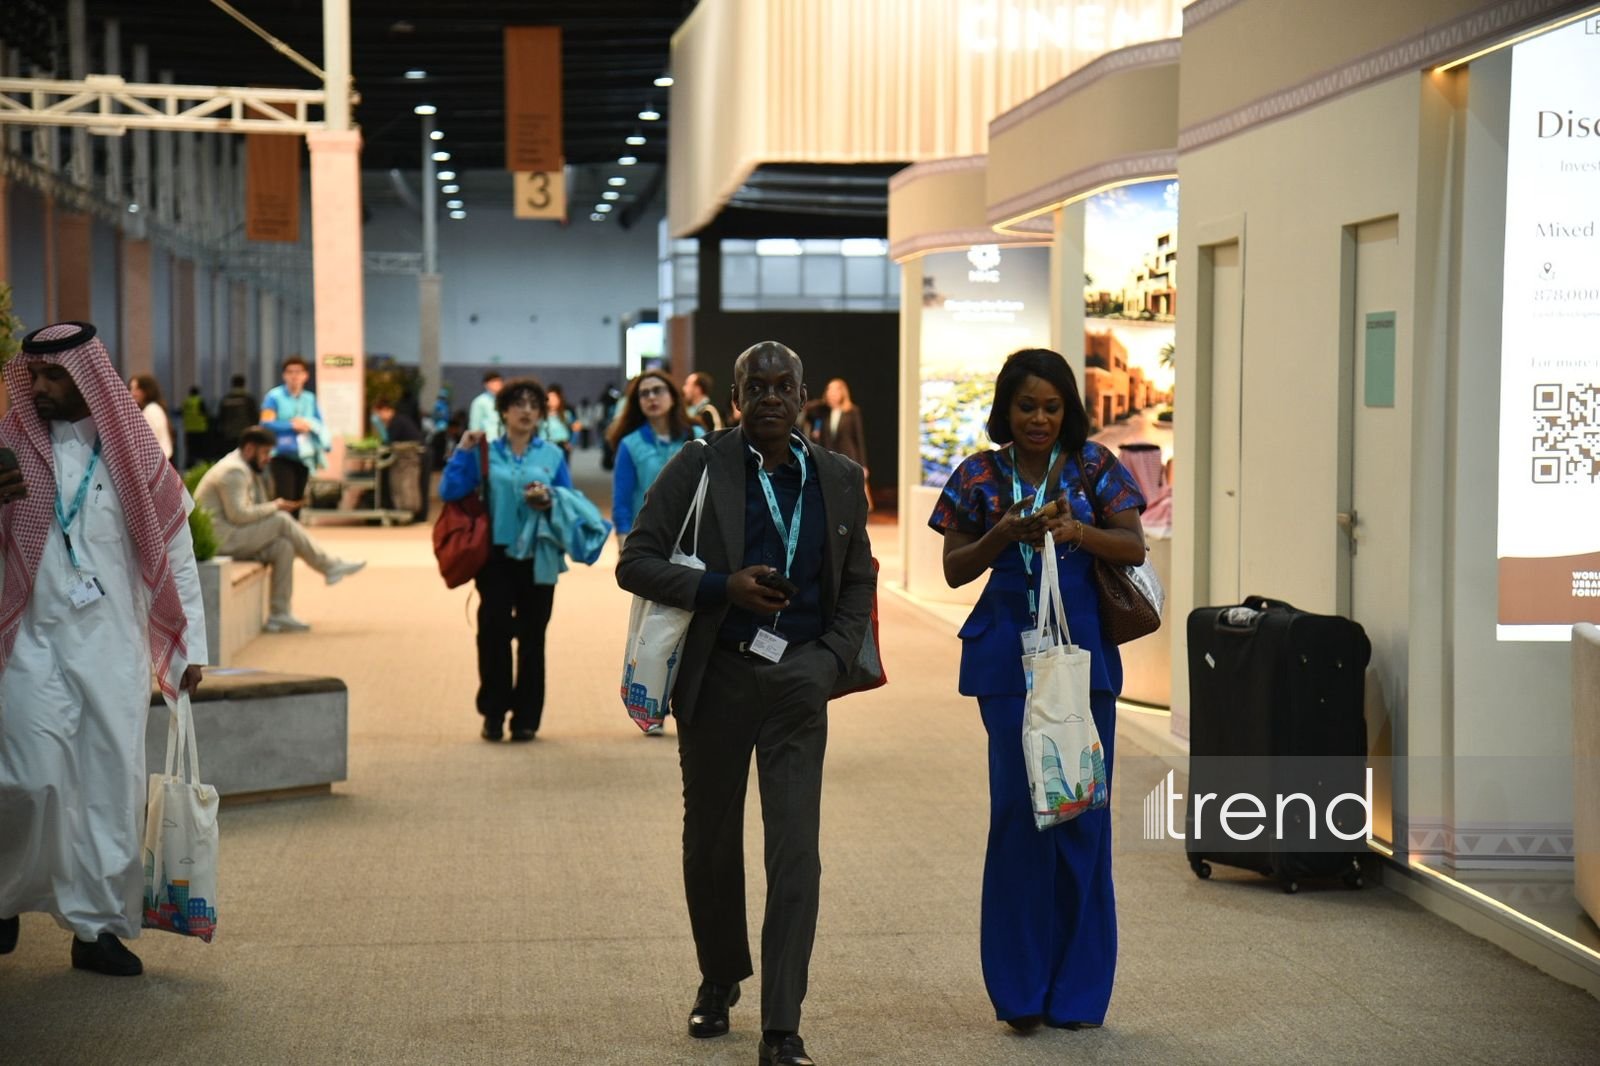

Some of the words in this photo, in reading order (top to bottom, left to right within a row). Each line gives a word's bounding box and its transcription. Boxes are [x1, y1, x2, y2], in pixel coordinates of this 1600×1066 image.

[527, 172, 551, 209] 3
[1536, 220, 1594, 237] Mixed
[1572, 571, 1600, 580] WORL
[1572, 580, 1600, 588] URBA
[1572, 588, 1600, 597] FORU
